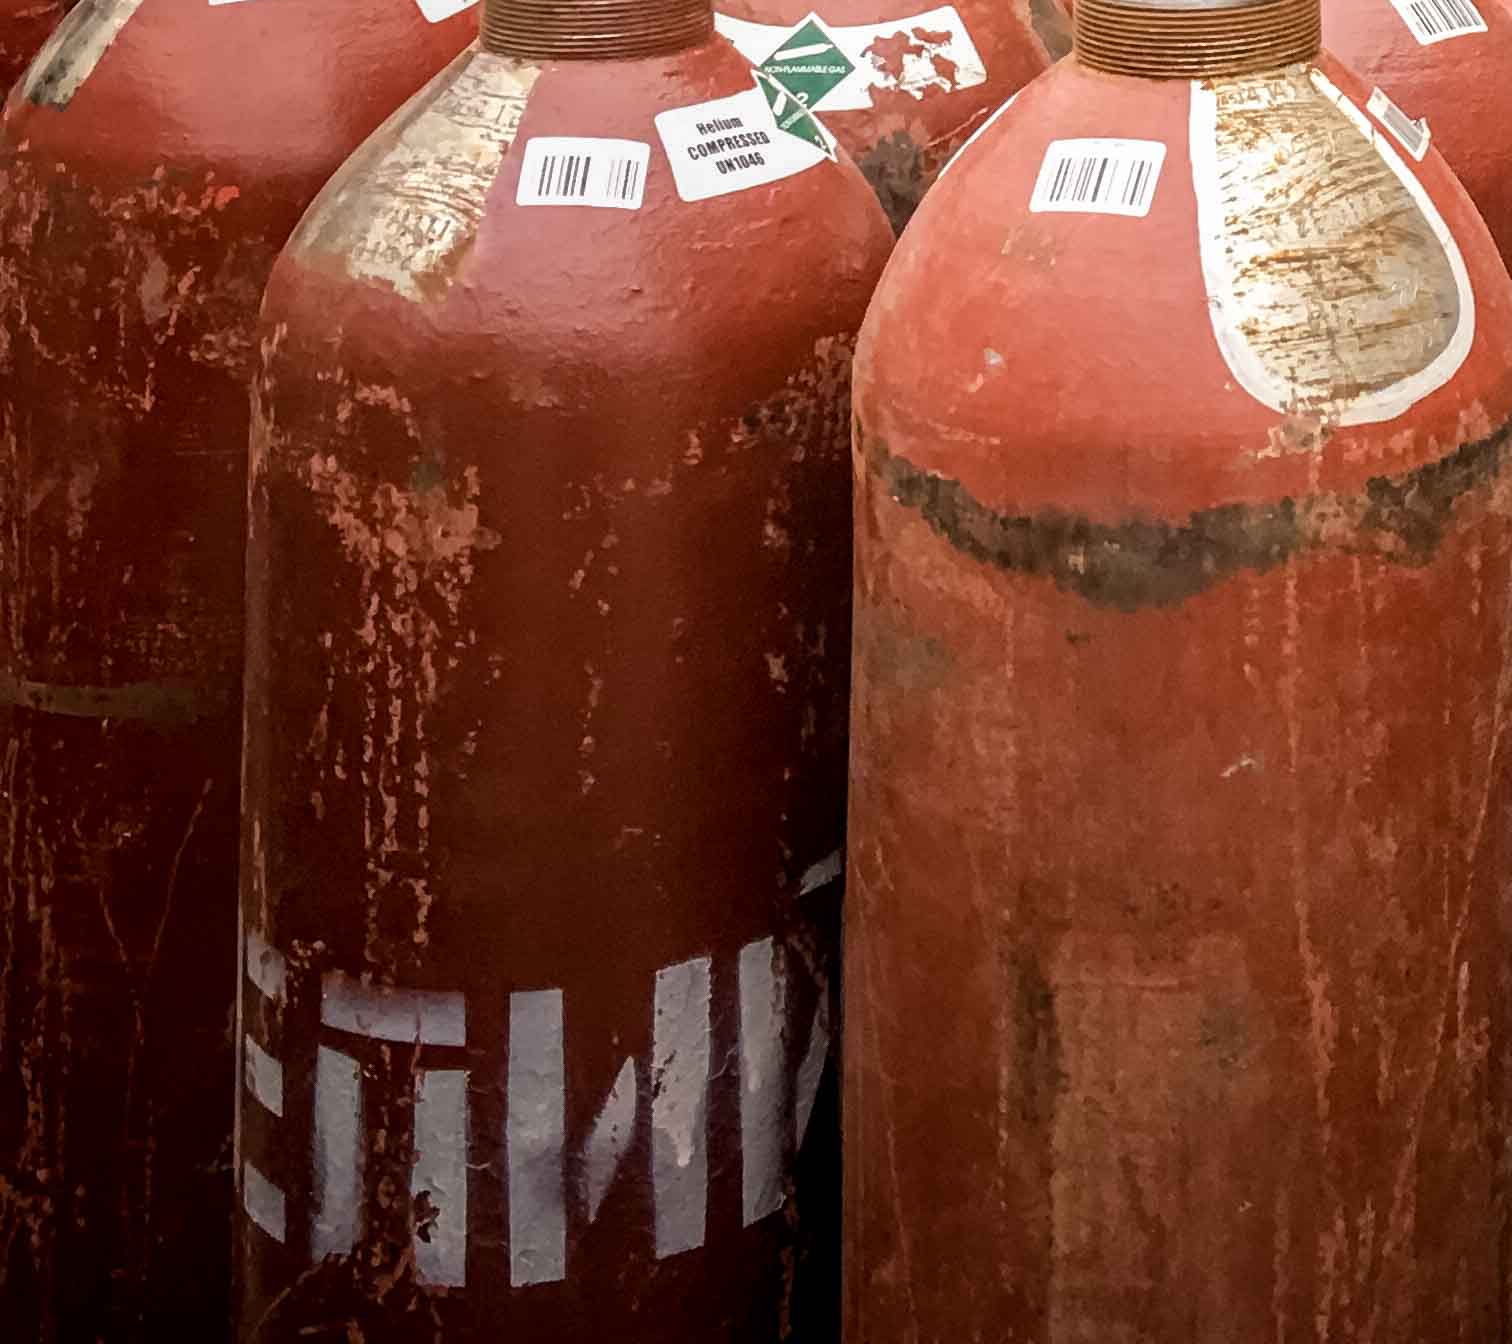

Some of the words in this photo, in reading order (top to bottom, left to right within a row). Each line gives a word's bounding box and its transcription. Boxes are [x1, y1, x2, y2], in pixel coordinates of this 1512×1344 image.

[827, 65, 846, 75] GAS
[695, 116, 745, 136] Helium
[687, 131, 771, 161] COMPRESSED
